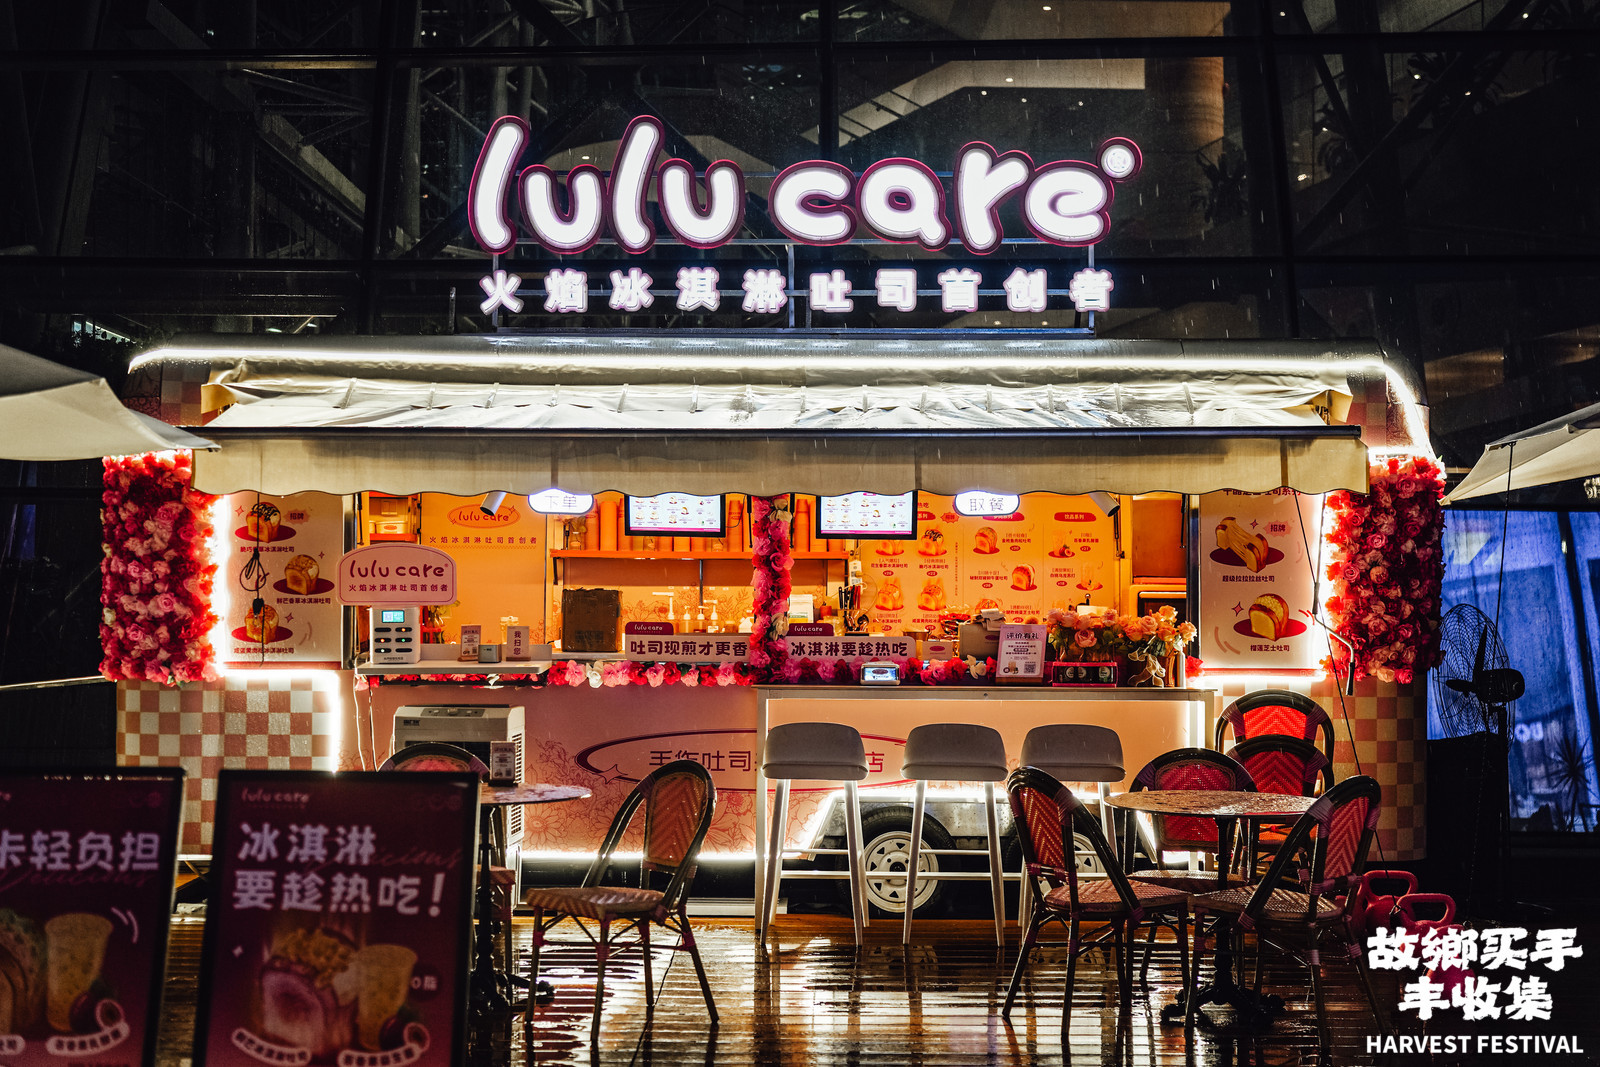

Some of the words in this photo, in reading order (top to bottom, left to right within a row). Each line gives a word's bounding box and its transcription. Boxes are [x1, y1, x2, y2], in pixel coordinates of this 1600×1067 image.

[468, 115, 744, 254] lulu
[768, 140, 1113, 254] care
[479, 267, 1113, 313] 火焰冰淇淋吐司首创者
[970, 498, 1003, 511] 取餐
[458, 511, 480, 521] lulu
[429, 536, 537, 544] 火焰冰淇淋吐司首创者
[350, 560, 389, 577] lulu
[395, 564, 444, 577] care
[349, 584, 448, 592] 火焰冰淇淋吐司首创者
[630, 640, 748, 656] 吐司现煎才更香
[790, 641, 908, 656] 冰淇淋要趁热吃
[0, 829, 160, 872] 卡轻负担
[238, 823, 377, 865] 冰淇淋
[233, 870, 446, 917] 要趁热吃！
